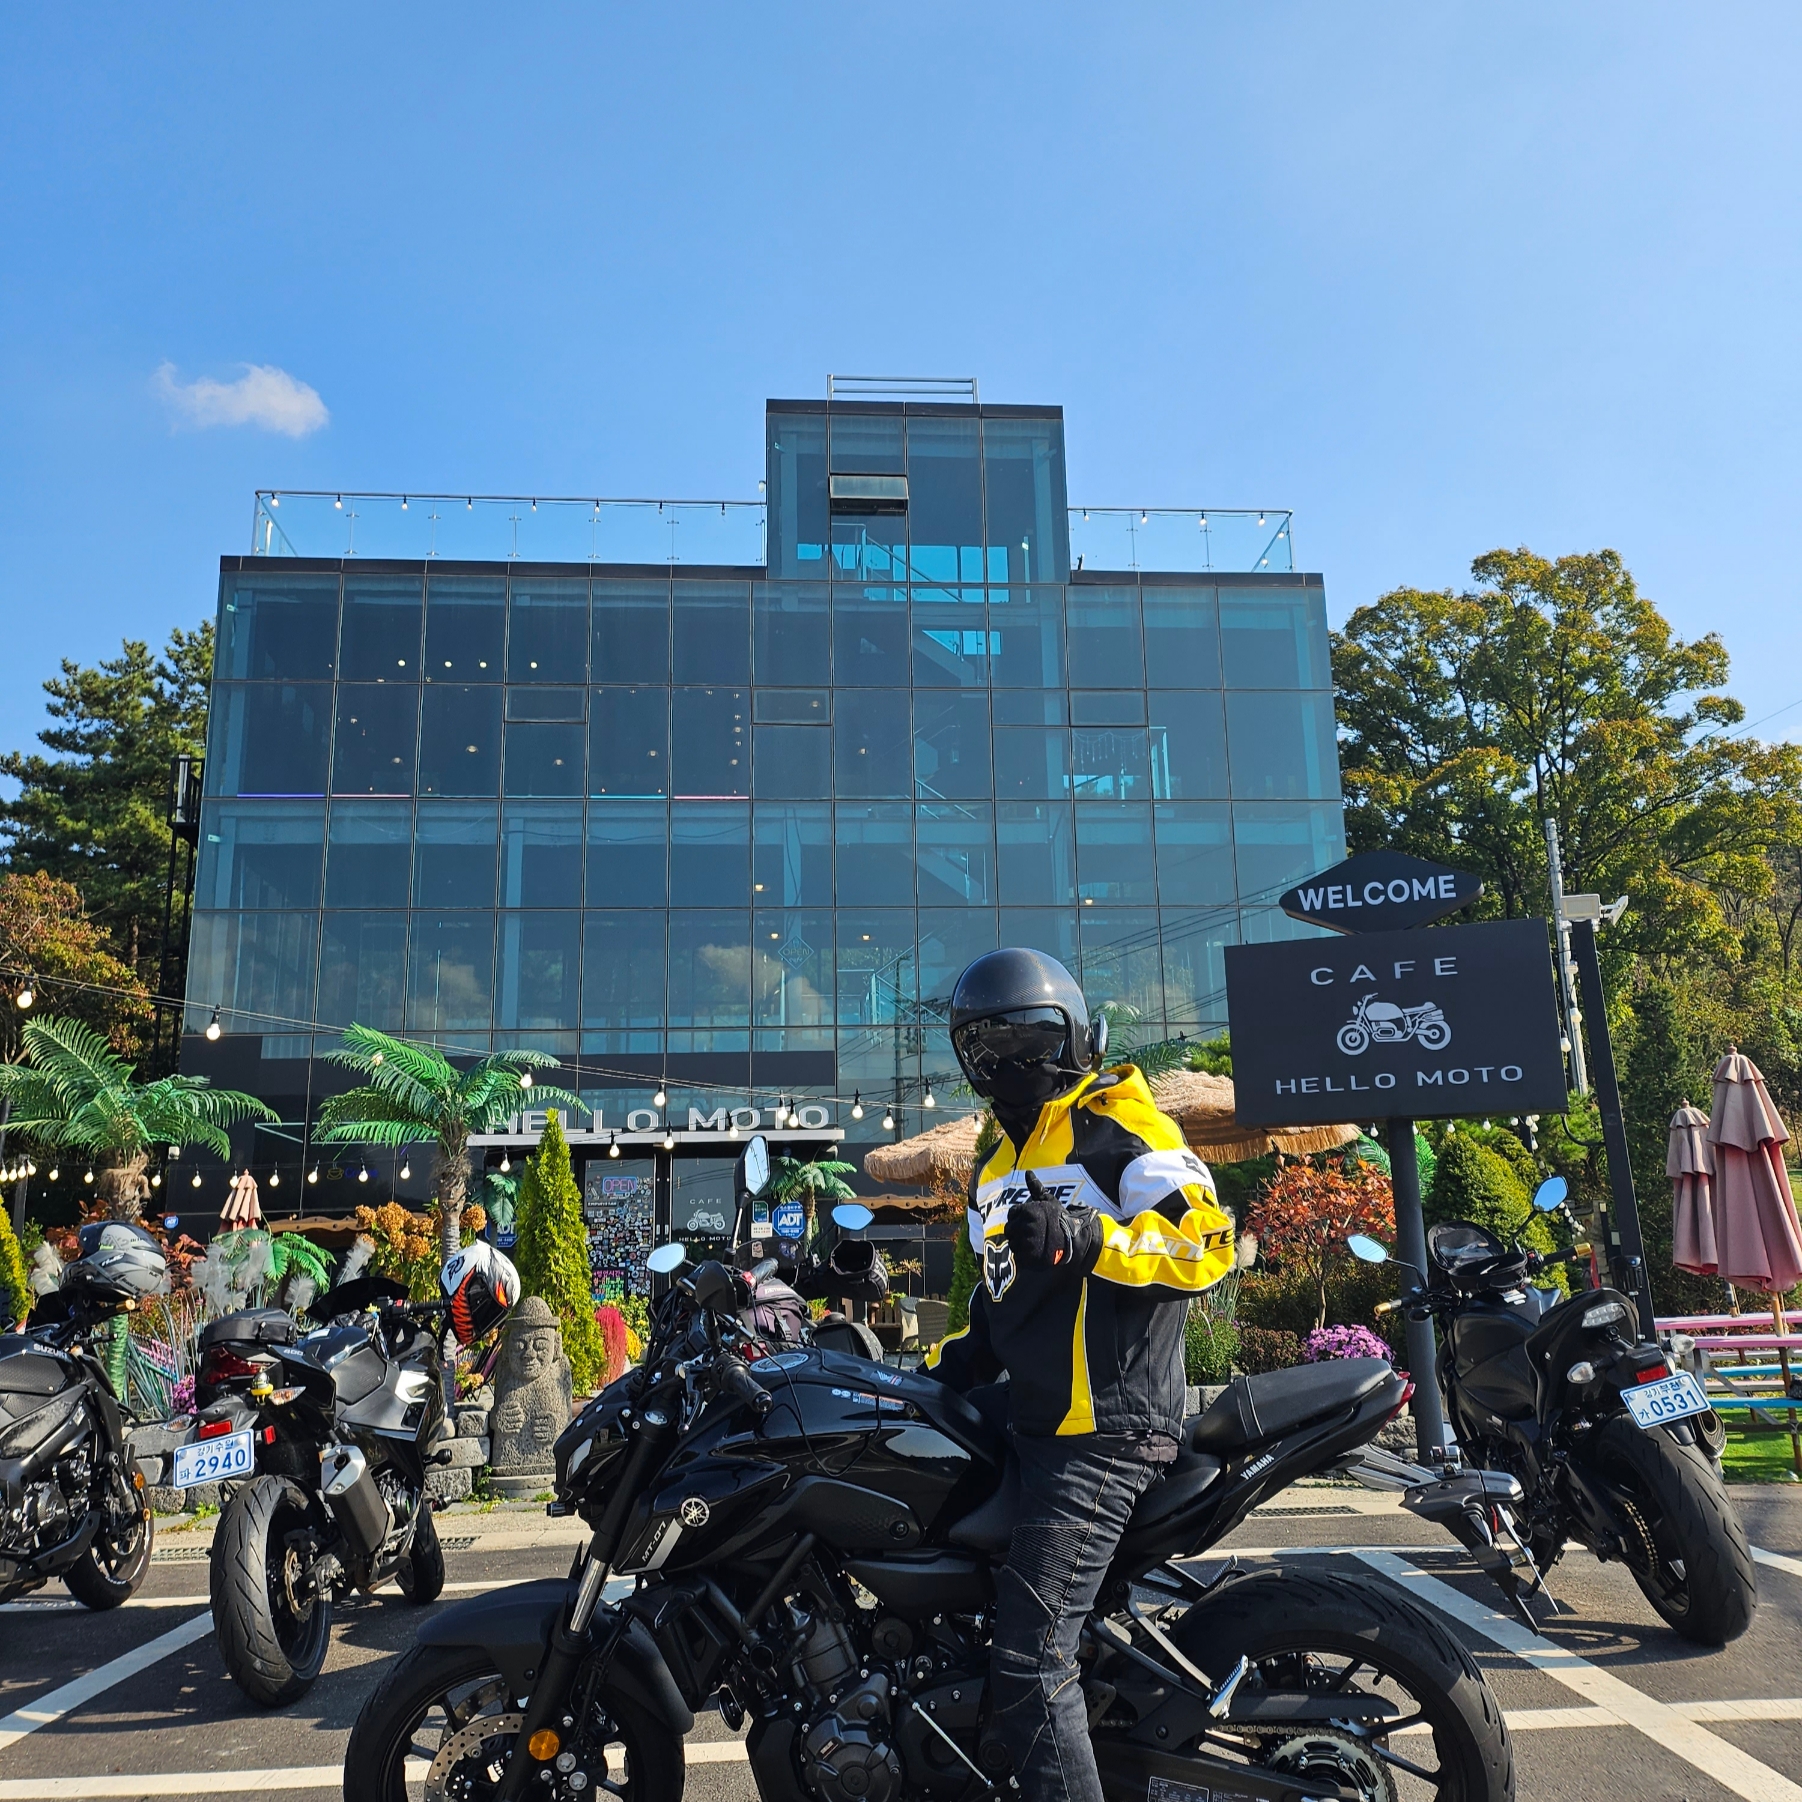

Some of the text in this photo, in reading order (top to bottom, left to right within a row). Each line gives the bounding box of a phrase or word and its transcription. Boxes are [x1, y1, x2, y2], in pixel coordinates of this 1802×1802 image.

[1297, 874, 1457, 911] WELCOME
[782, 948, 809, 956] OPEN
[1310, 956, 1458, 985] CAFE
[1275, 1065, 1523, 1095] HELLO MOTO
[485, 1105, 830, 1135] HELLO MOTO
[604, 1179, 636, 1192] OPEN
[778, 1212, 803, 1227] ADT
[33, 1342, 68, 1360] SUZUKI
[283, 1348, 304, 1356] 400
[1638, 1389, 1699, 1420] 가 0531
[179, 1448, 247, 1480] 파 2940
[1240, 1453, 1275, 1480] YAMAHA
[641, 1520, 667, 1562] MT-07
